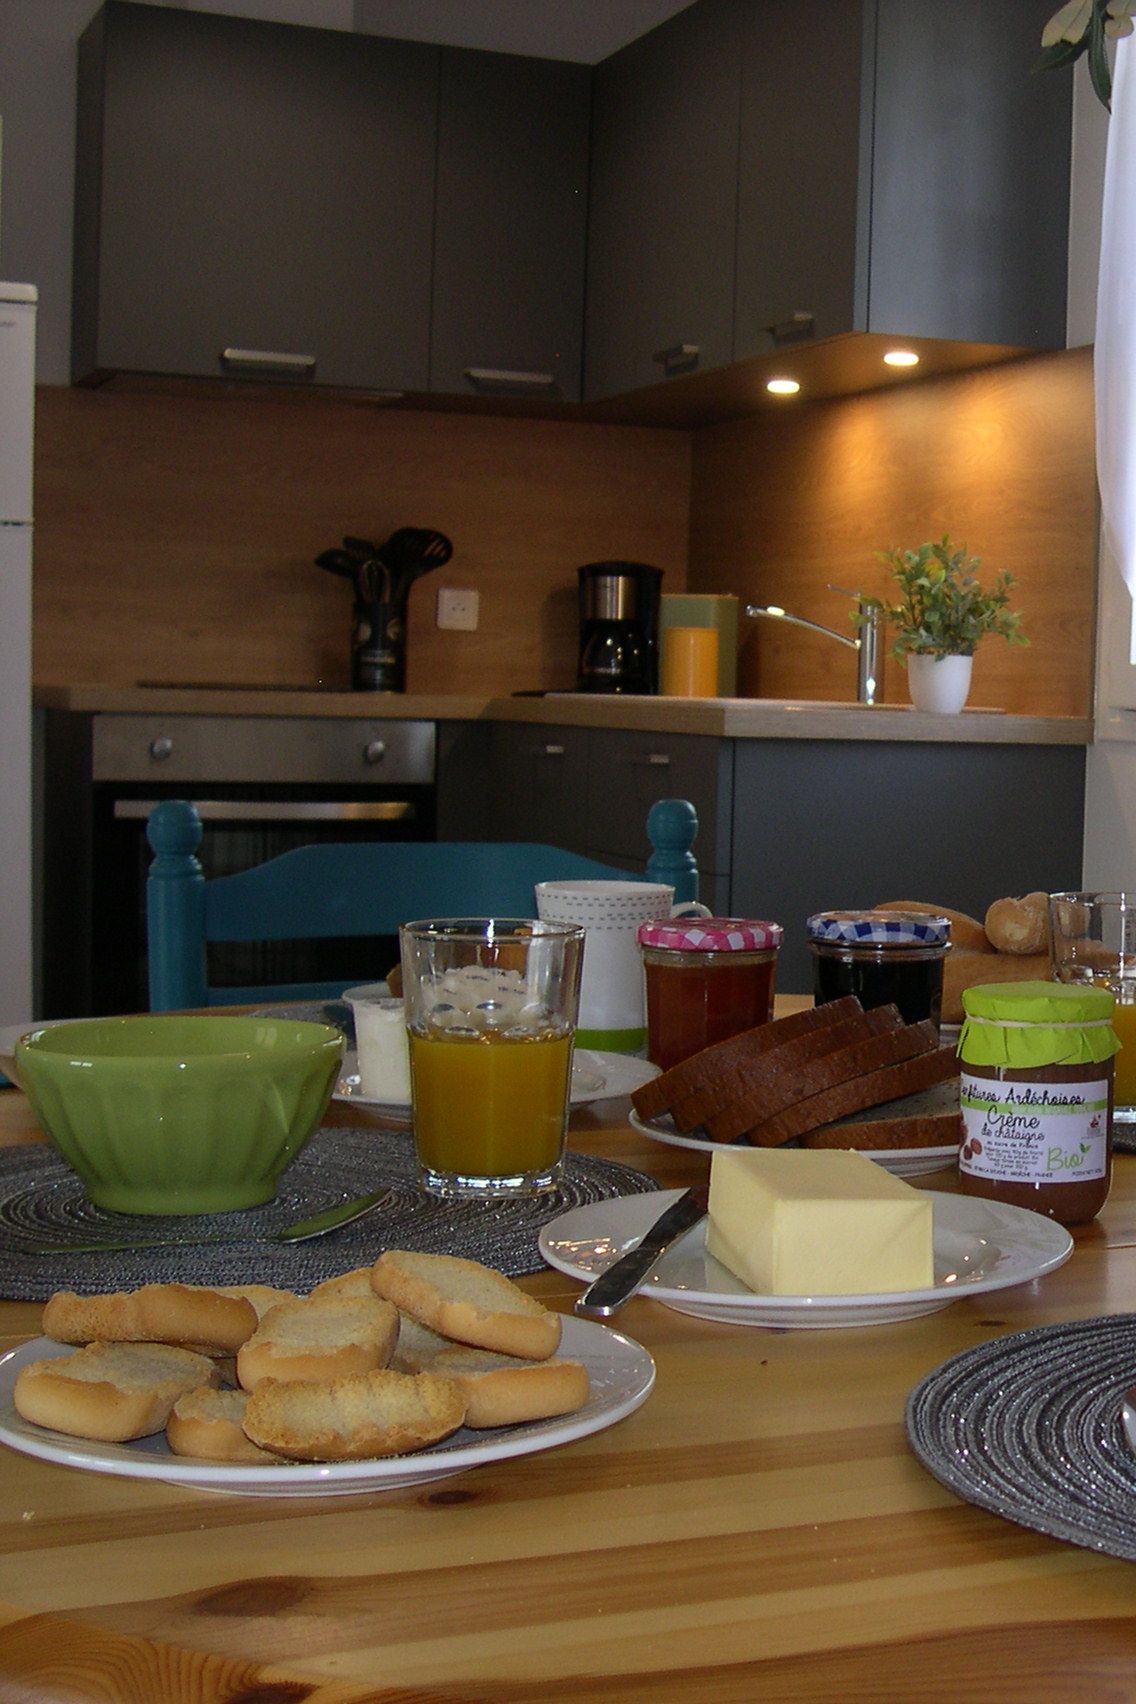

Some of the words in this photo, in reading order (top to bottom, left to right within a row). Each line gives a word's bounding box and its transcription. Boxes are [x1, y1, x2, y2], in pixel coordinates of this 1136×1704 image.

[1005, 1087, 1086, 1106] Ardéchoises
[987, 1105, 1040, 1129] Crème
[994, 1124, 1045, 1144] châtaigne
[1047, 1147, 1084, 1171] Bio
